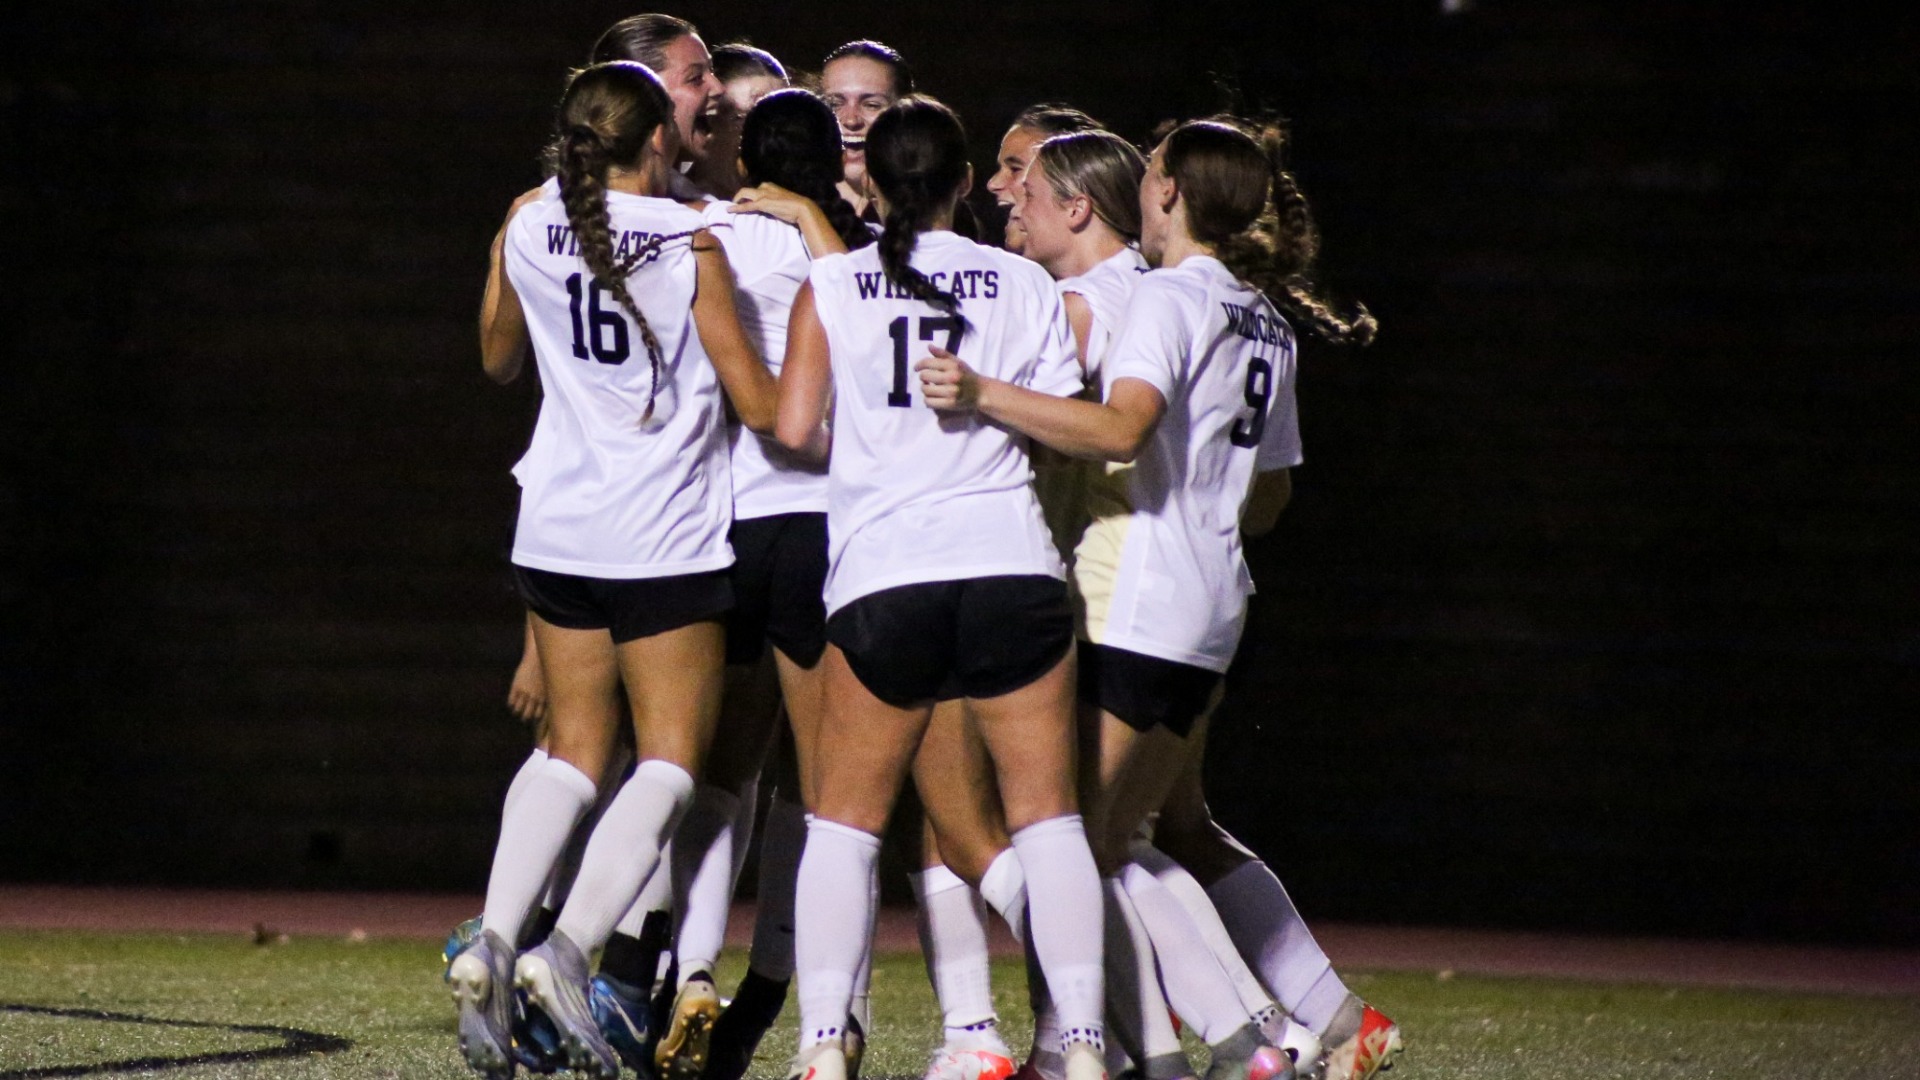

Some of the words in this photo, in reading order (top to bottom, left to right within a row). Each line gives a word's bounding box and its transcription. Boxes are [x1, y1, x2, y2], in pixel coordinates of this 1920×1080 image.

[547, 224, 663, 262] WIATS
[565, 272, 630, 365] 16
[1230, 356, 1272, 449] 9
